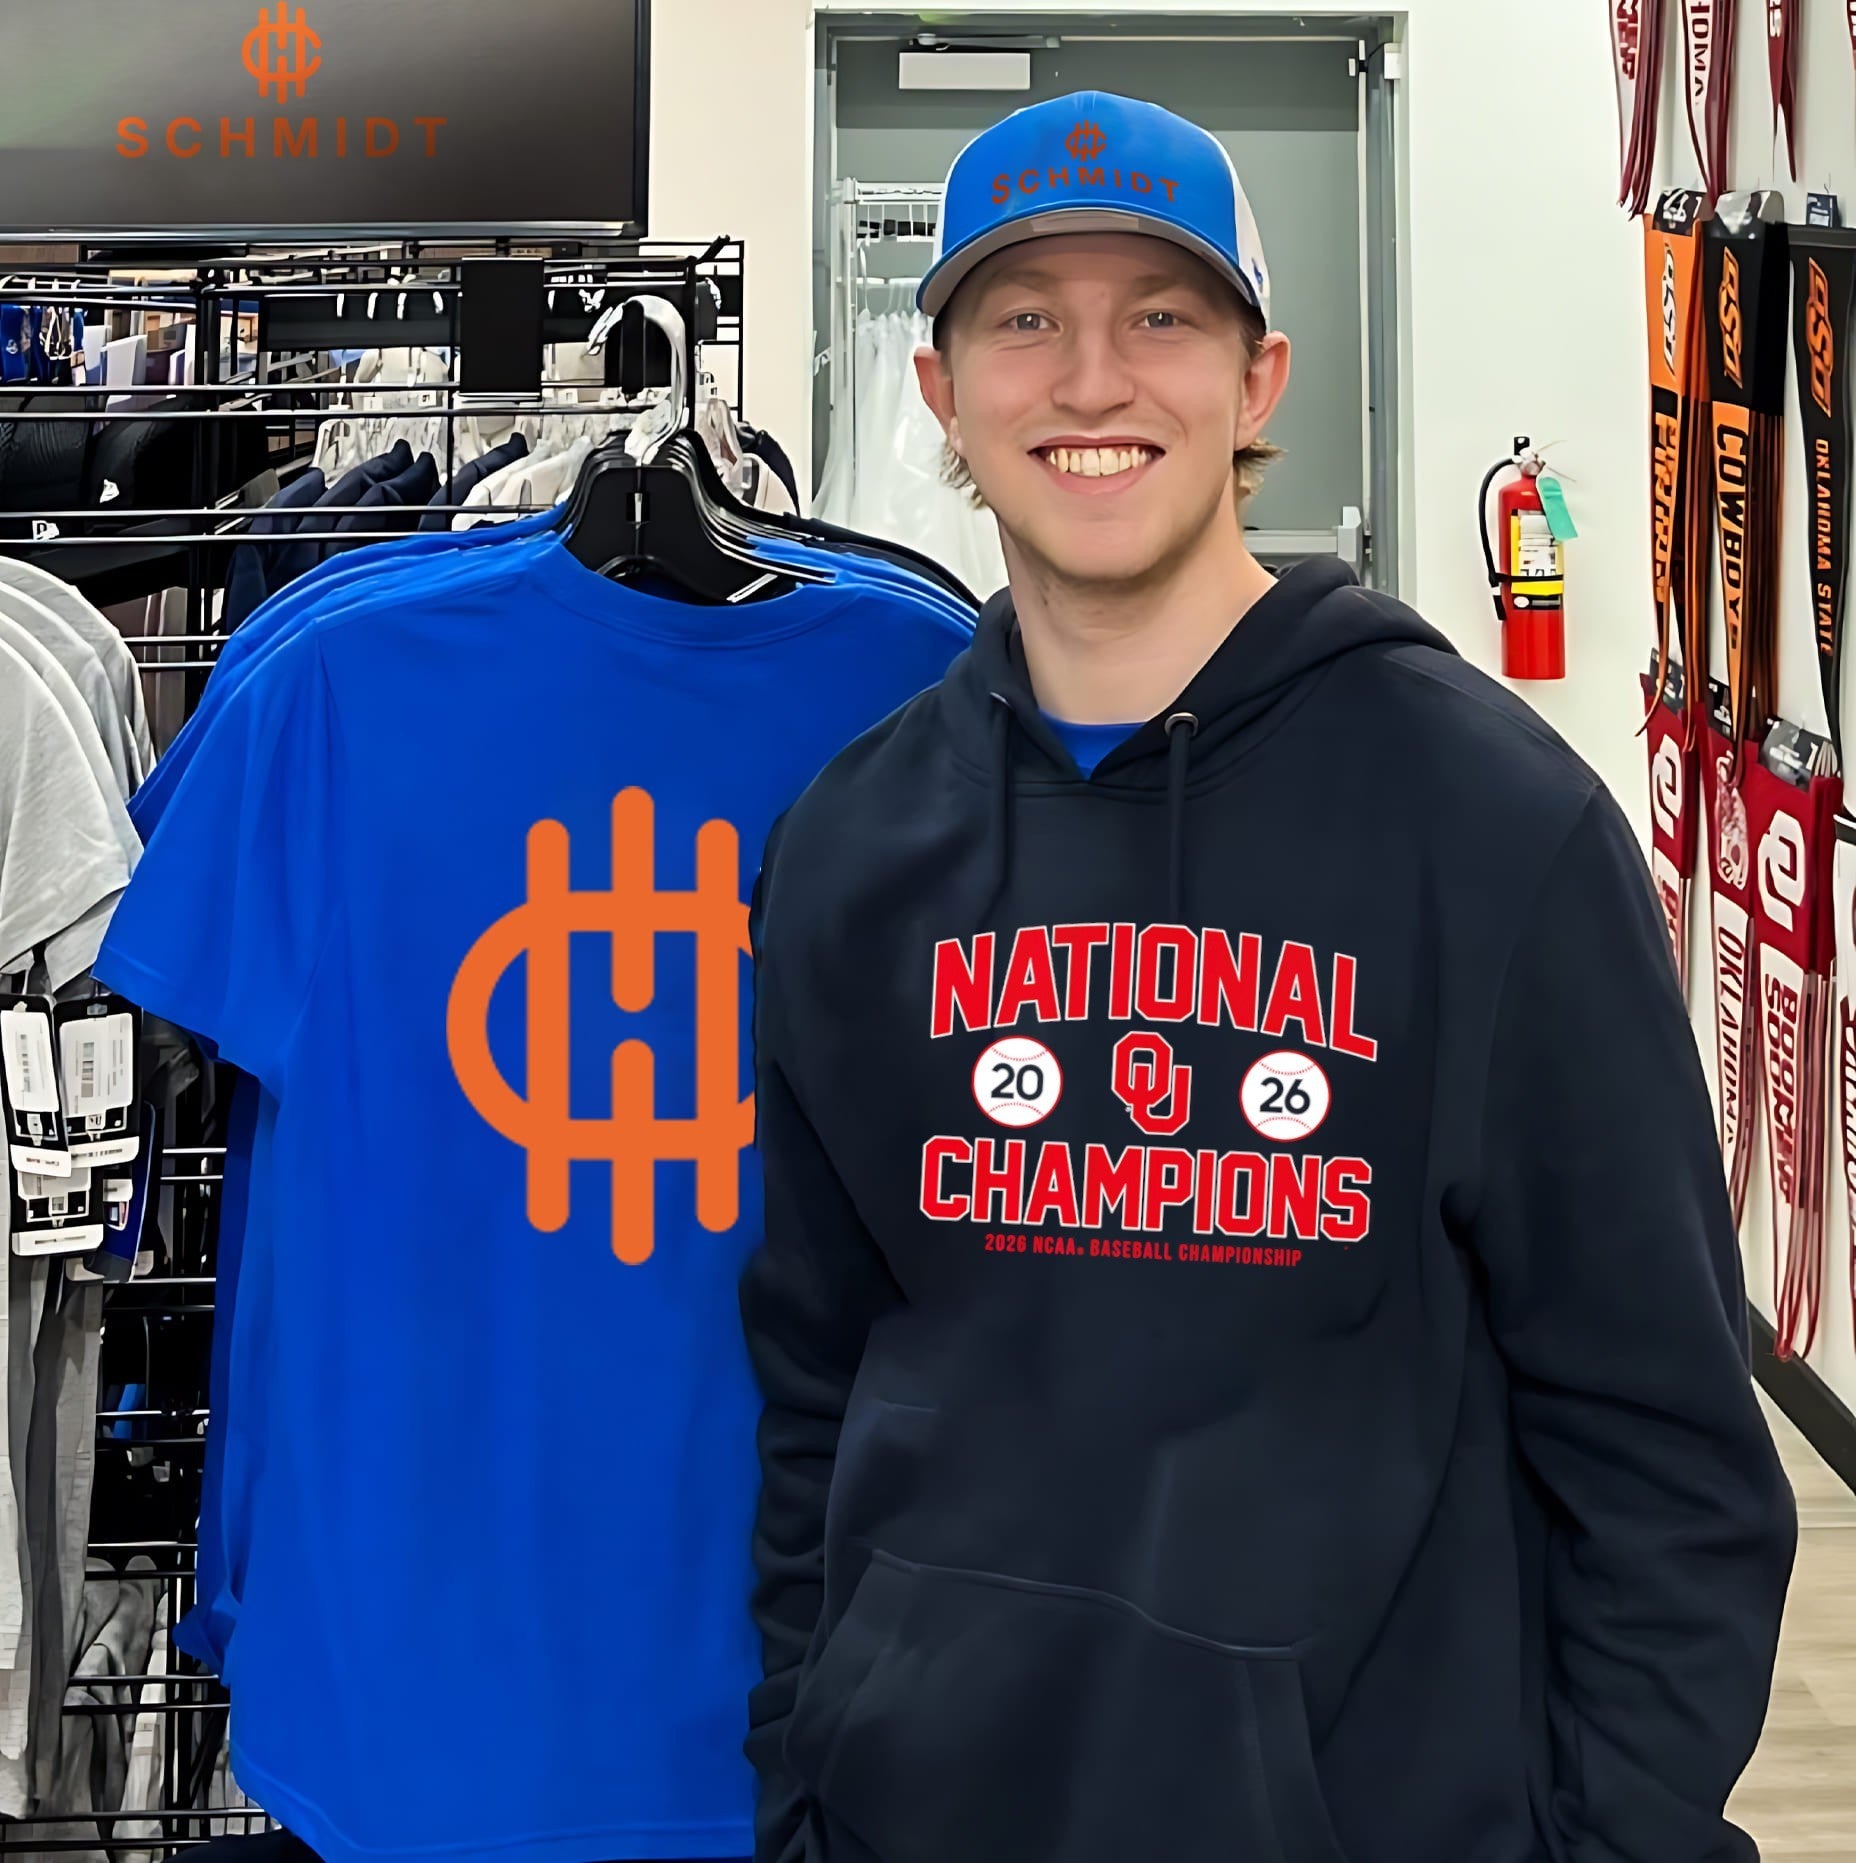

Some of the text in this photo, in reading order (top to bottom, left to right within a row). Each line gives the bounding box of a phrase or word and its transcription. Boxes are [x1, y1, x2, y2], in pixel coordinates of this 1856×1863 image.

[116, 116, 448, 159] SCHMIDT
[991, 166, 1180, 206] SCHMIDT
[1815, 437, 1833, 570] OKLAHOMA
[931, 922, 1378, 1062] NATIONAL
[990, 1062, 1044, 1101] 20
[1111, 1031, 1192, 1136] OU
[1259, 1076, 1311, 1115] 26
[919, 1135, 1373, 1243] CHAMPIONS
[984, 1233, 1027, 1253] 2026
[1090, 1238, 1173, 1261] BASEBALL
[1178, 1243, 1302, 1267] CHAMPIONSHIP
